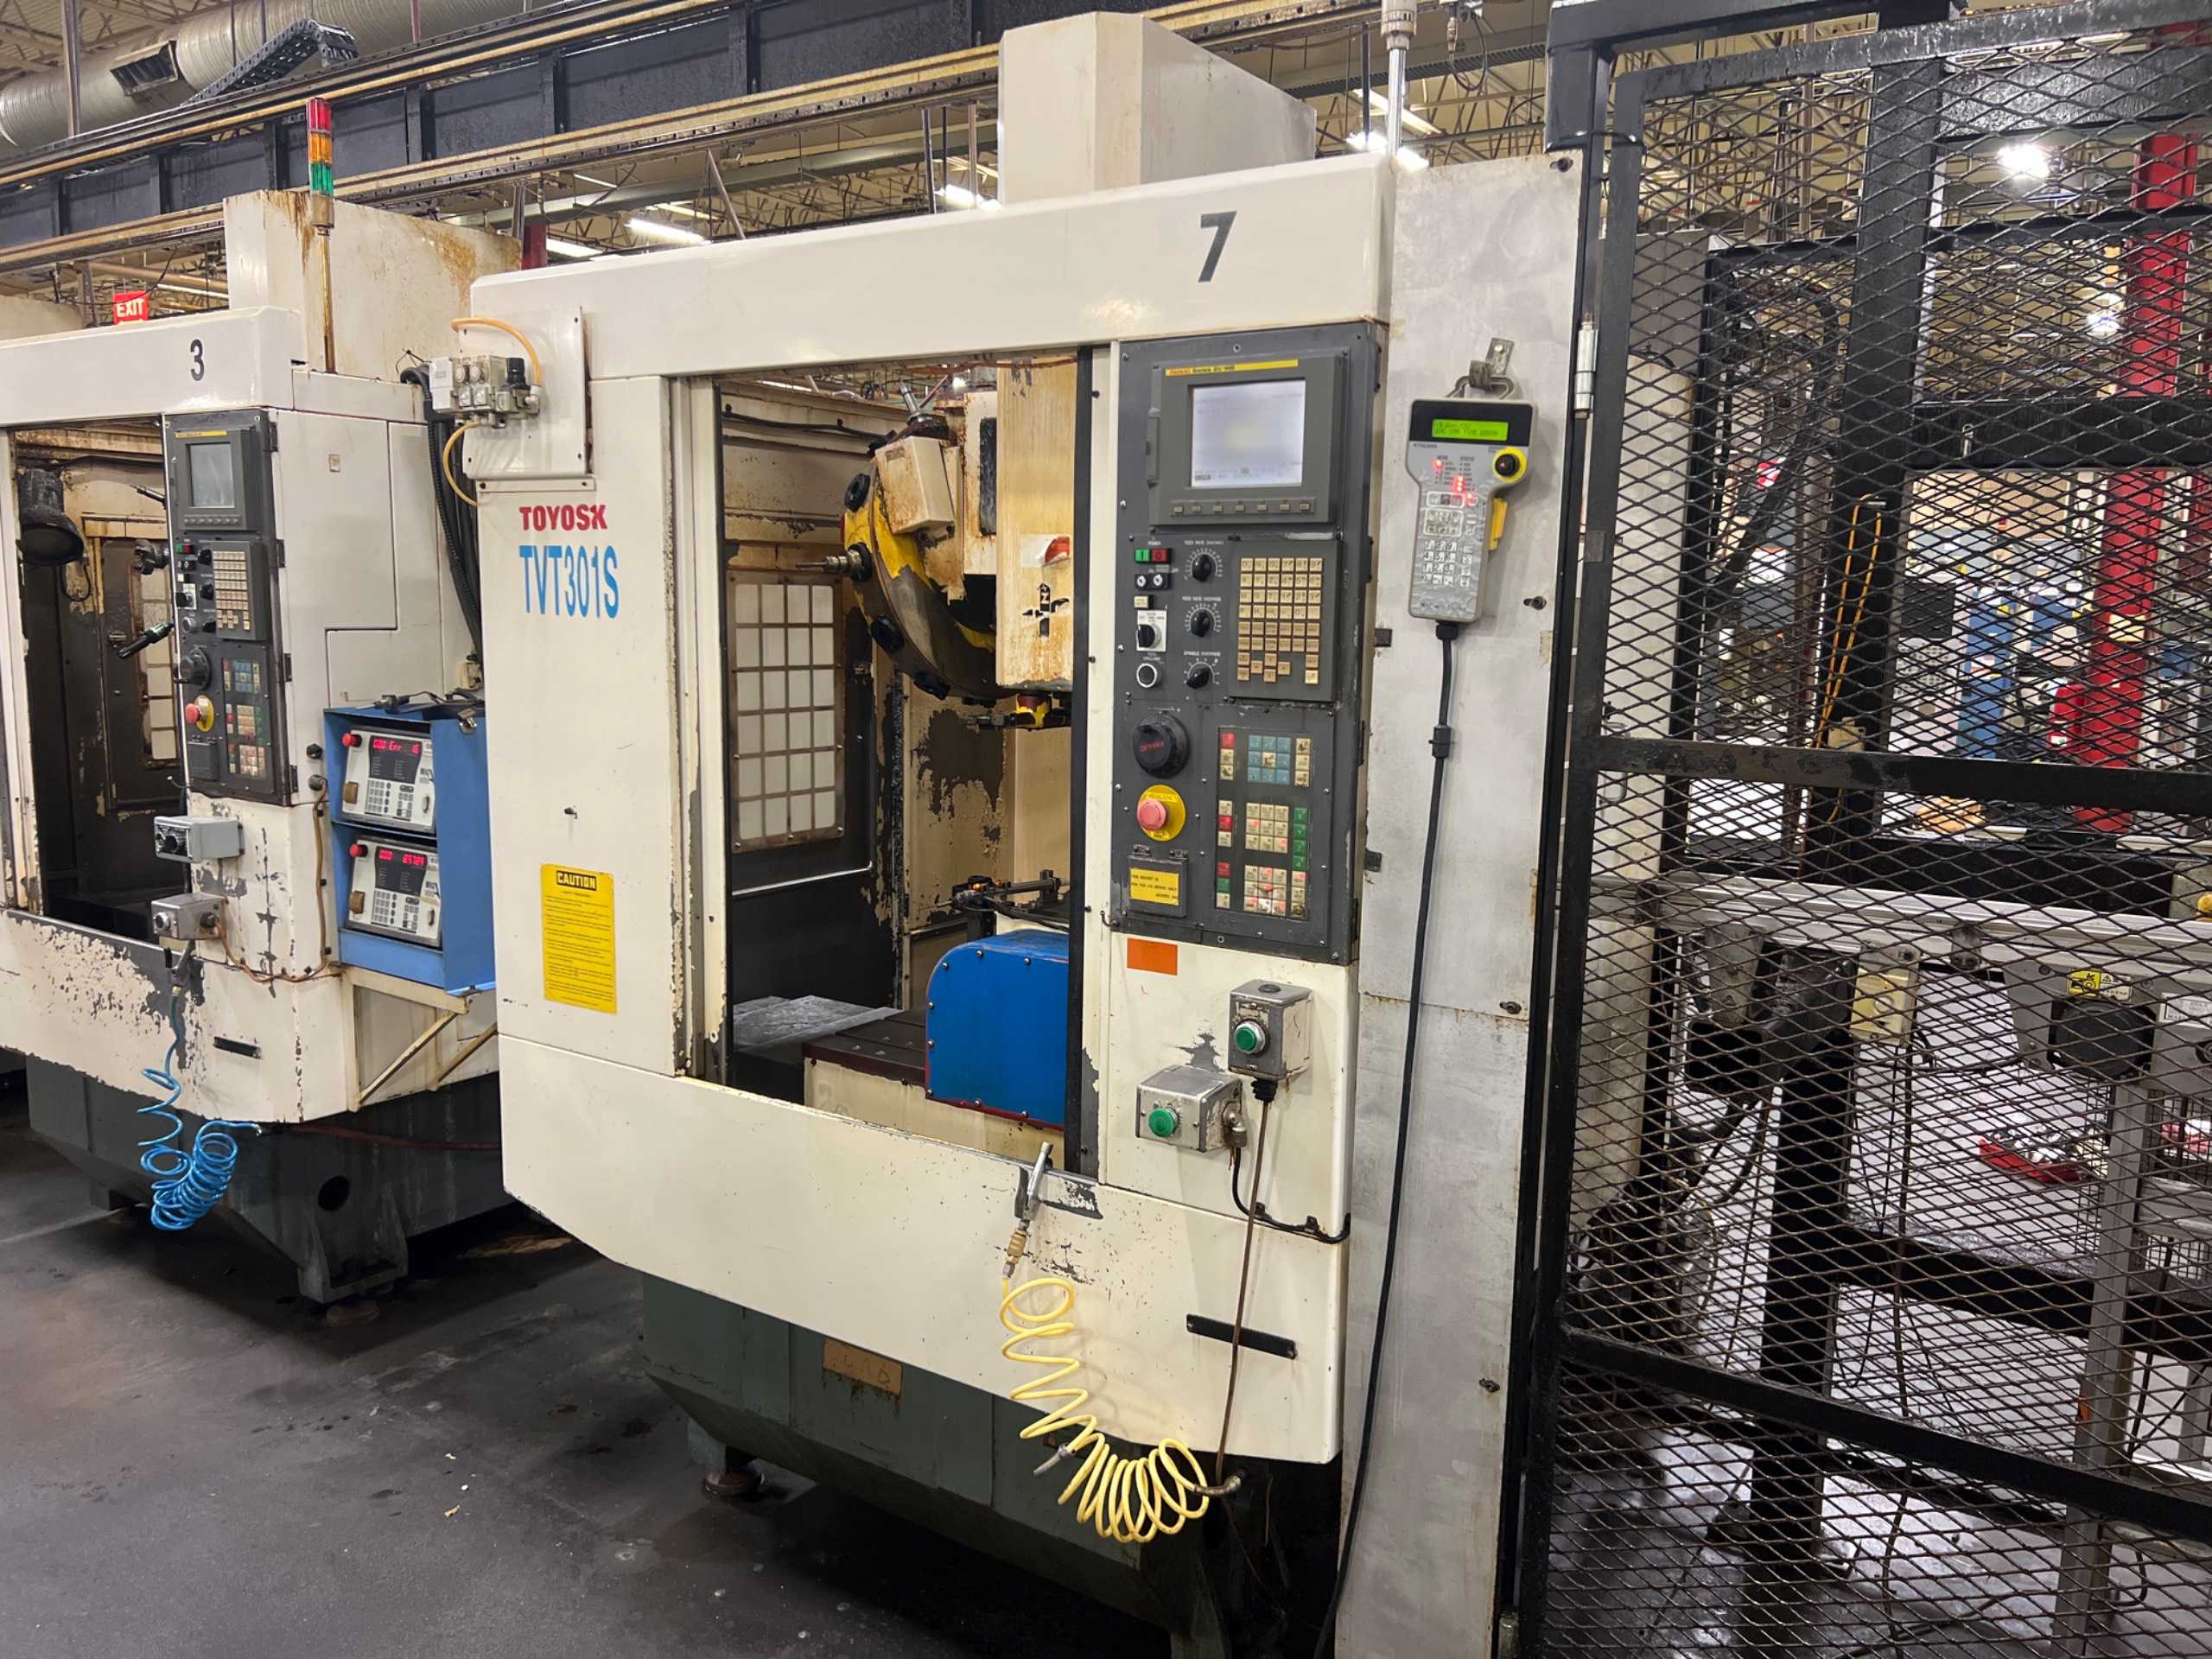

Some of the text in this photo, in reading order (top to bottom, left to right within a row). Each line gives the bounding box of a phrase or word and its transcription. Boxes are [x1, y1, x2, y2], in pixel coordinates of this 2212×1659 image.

[1198, 210, 1237, 283] 7
[116, 298, 144, 319] EXIT
[190, 339, 205, 381] 3
[518, 504, 608, 531] TOYOSK
[518, 544, 620, 619] TVT301S
[557, 871, 595, 890] CAUTION
